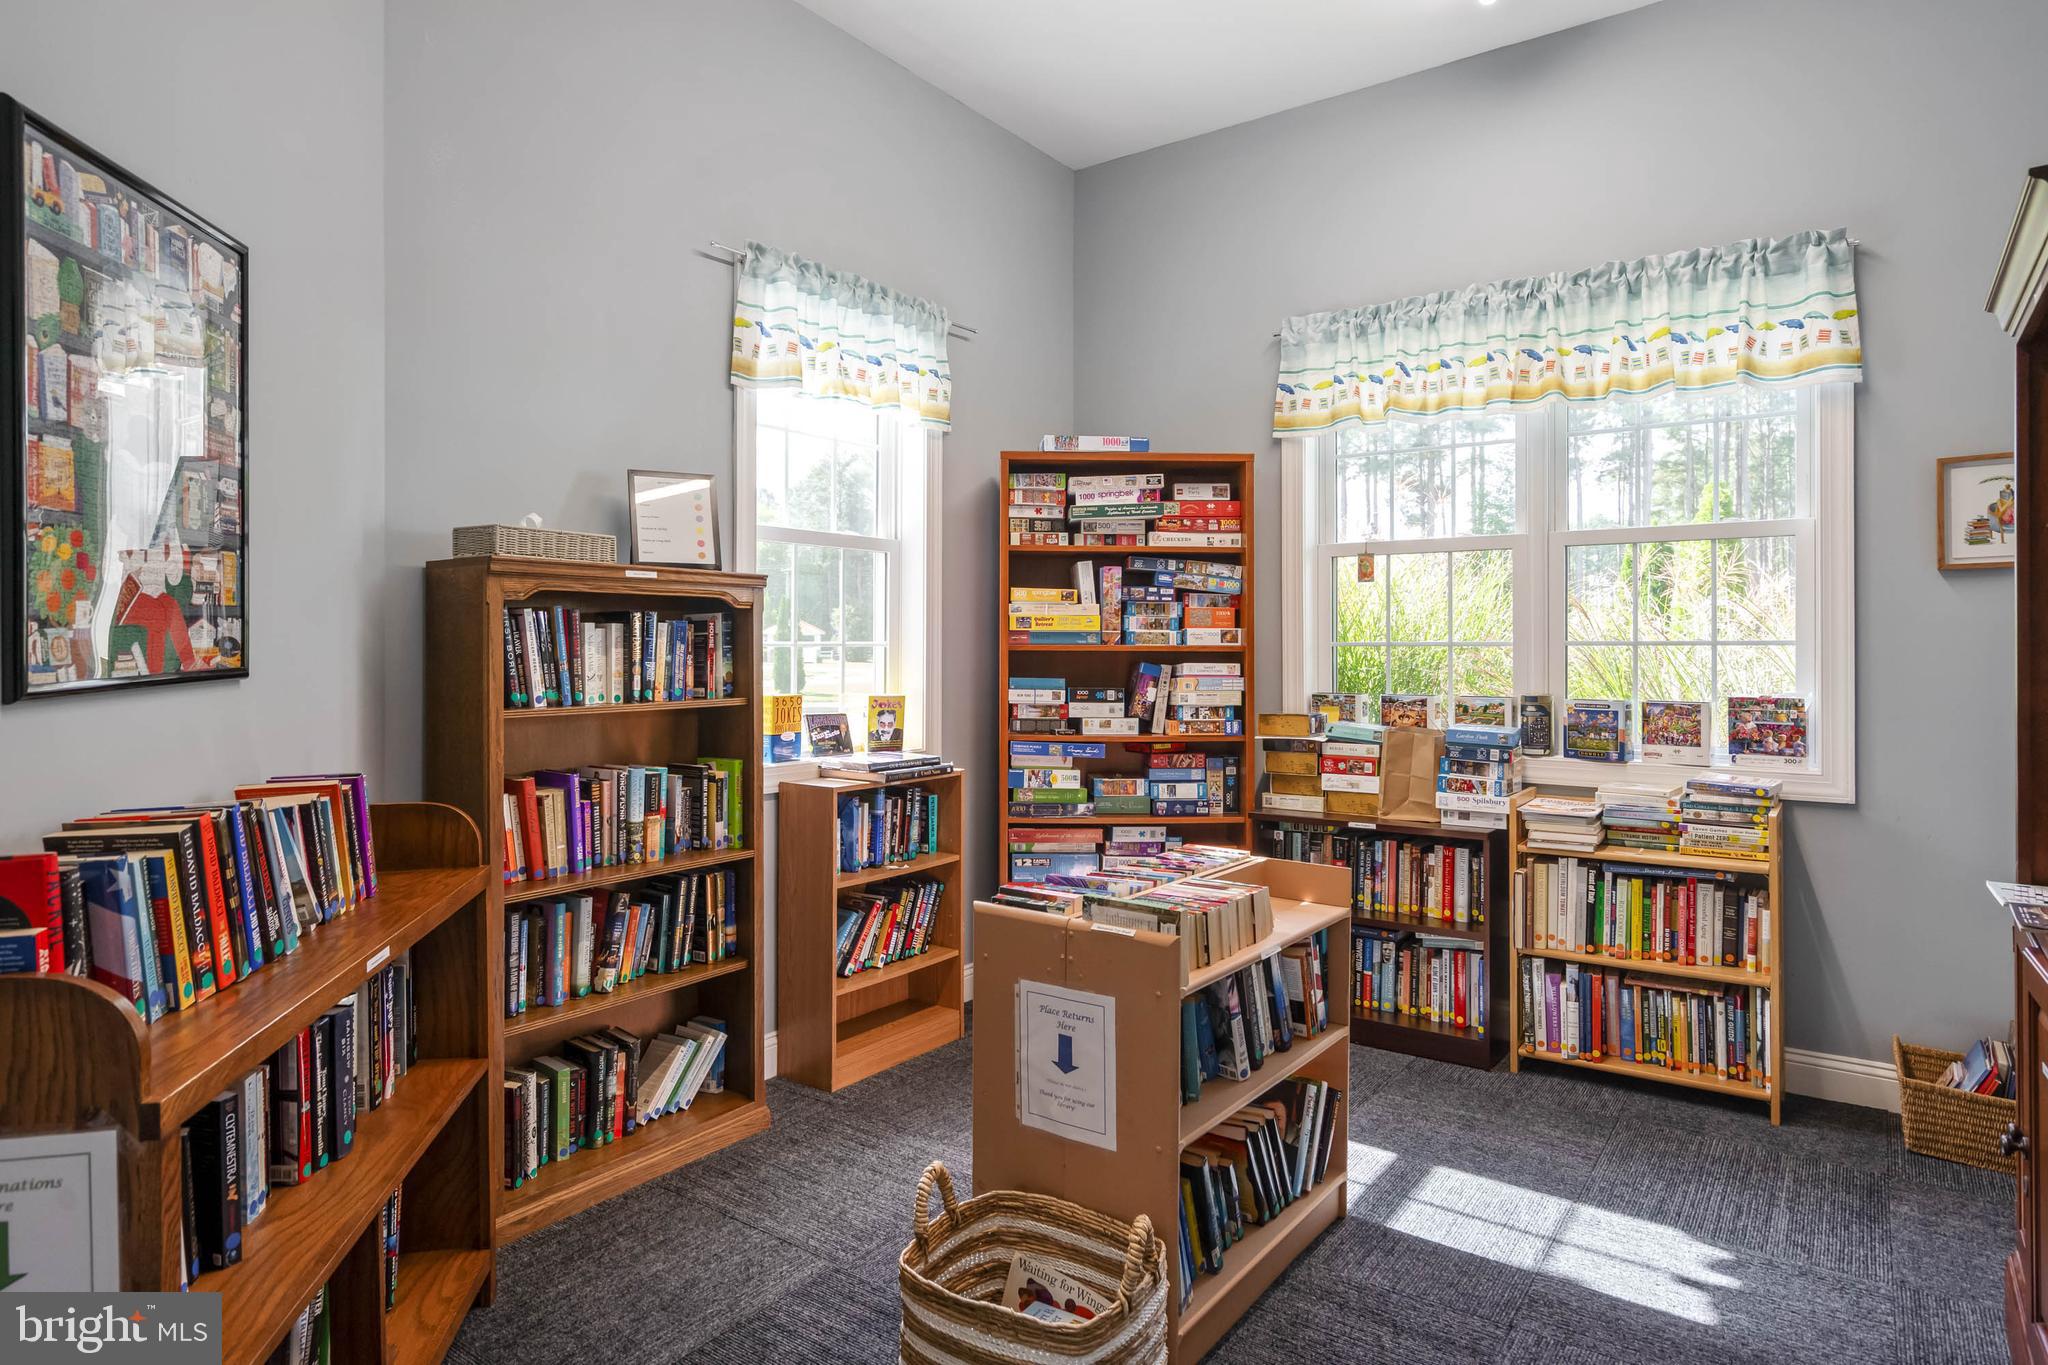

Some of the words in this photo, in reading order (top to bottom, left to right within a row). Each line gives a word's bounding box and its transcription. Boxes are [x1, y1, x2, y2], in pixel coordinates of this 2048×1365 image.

[774, 706, 802, 724] JOKES
[775, 697, 802, 706] 3650
[871, 699, 903, 710] Jokes
[619, 771, 627, 796] VINCE
[1471, 798, 1506, 807] Spilsbury
[1694, 833, 1714, 841] Patient
[184, 846, 199, 892] DAVID
[1588, 869, 1596, 884] Feast
[168, 873, 179, 905] DAVID
[211, 868, 223, 917] BALDACCI
[1587, 891, 1595, 903] Italy
[249, 910, 259, 928] END
[272, 910, 281, 930] LONG
[1701, 892, 1709, 922] Successful
[172, 905, 186, 955] BALDACCI
[191, 891, 206, 962] BALDACCI
[265, 906, 277, 941] SHADOWS
[1701, 922, 1709, 940] Aging
[1355, 938, 1363, 971] CONVICTION
[1039, 1004, 1060, 1018] Place
[1062, 1009, 1095, 1024] Returns
[1056, 1020, 1076, 1033] Here
[344, 1019, 352, 1069] RAINBOW
[341, 1088, 349, 1126] CLANCY
[224, 1113, 238, 1184] CLYTEMNESTRA
[316, 1115, 326, 1157] Kremlin
[1018, 1257, 1056, 1287] Waiting
[1060, 1277, 1076, 1295] for
[1077, 1286, 1111, 1315] Wings
